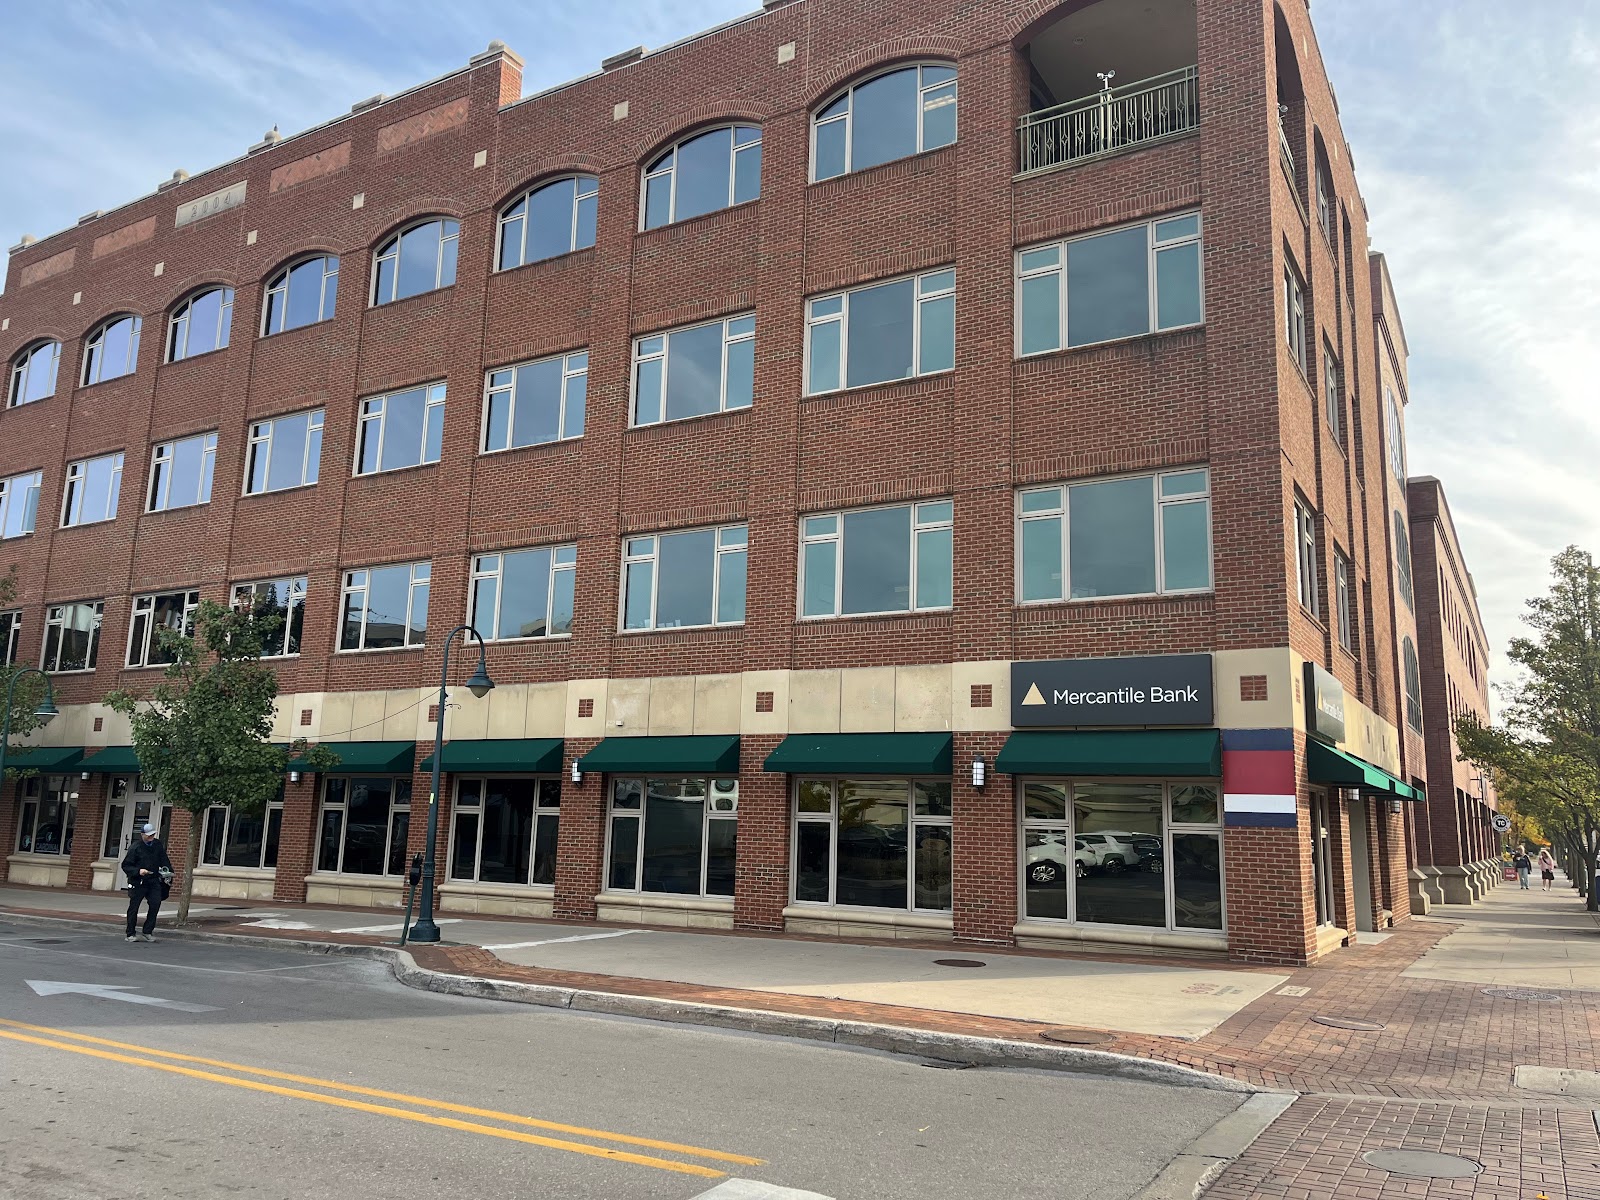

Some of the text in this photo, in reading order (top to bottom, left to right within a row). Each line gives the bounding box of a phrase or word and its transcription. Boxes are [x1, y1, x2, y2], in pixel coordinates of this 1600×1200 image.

[191, 192, 231, 217] 2004
[1053, 685, 1199, 705] Mercantile Bank
